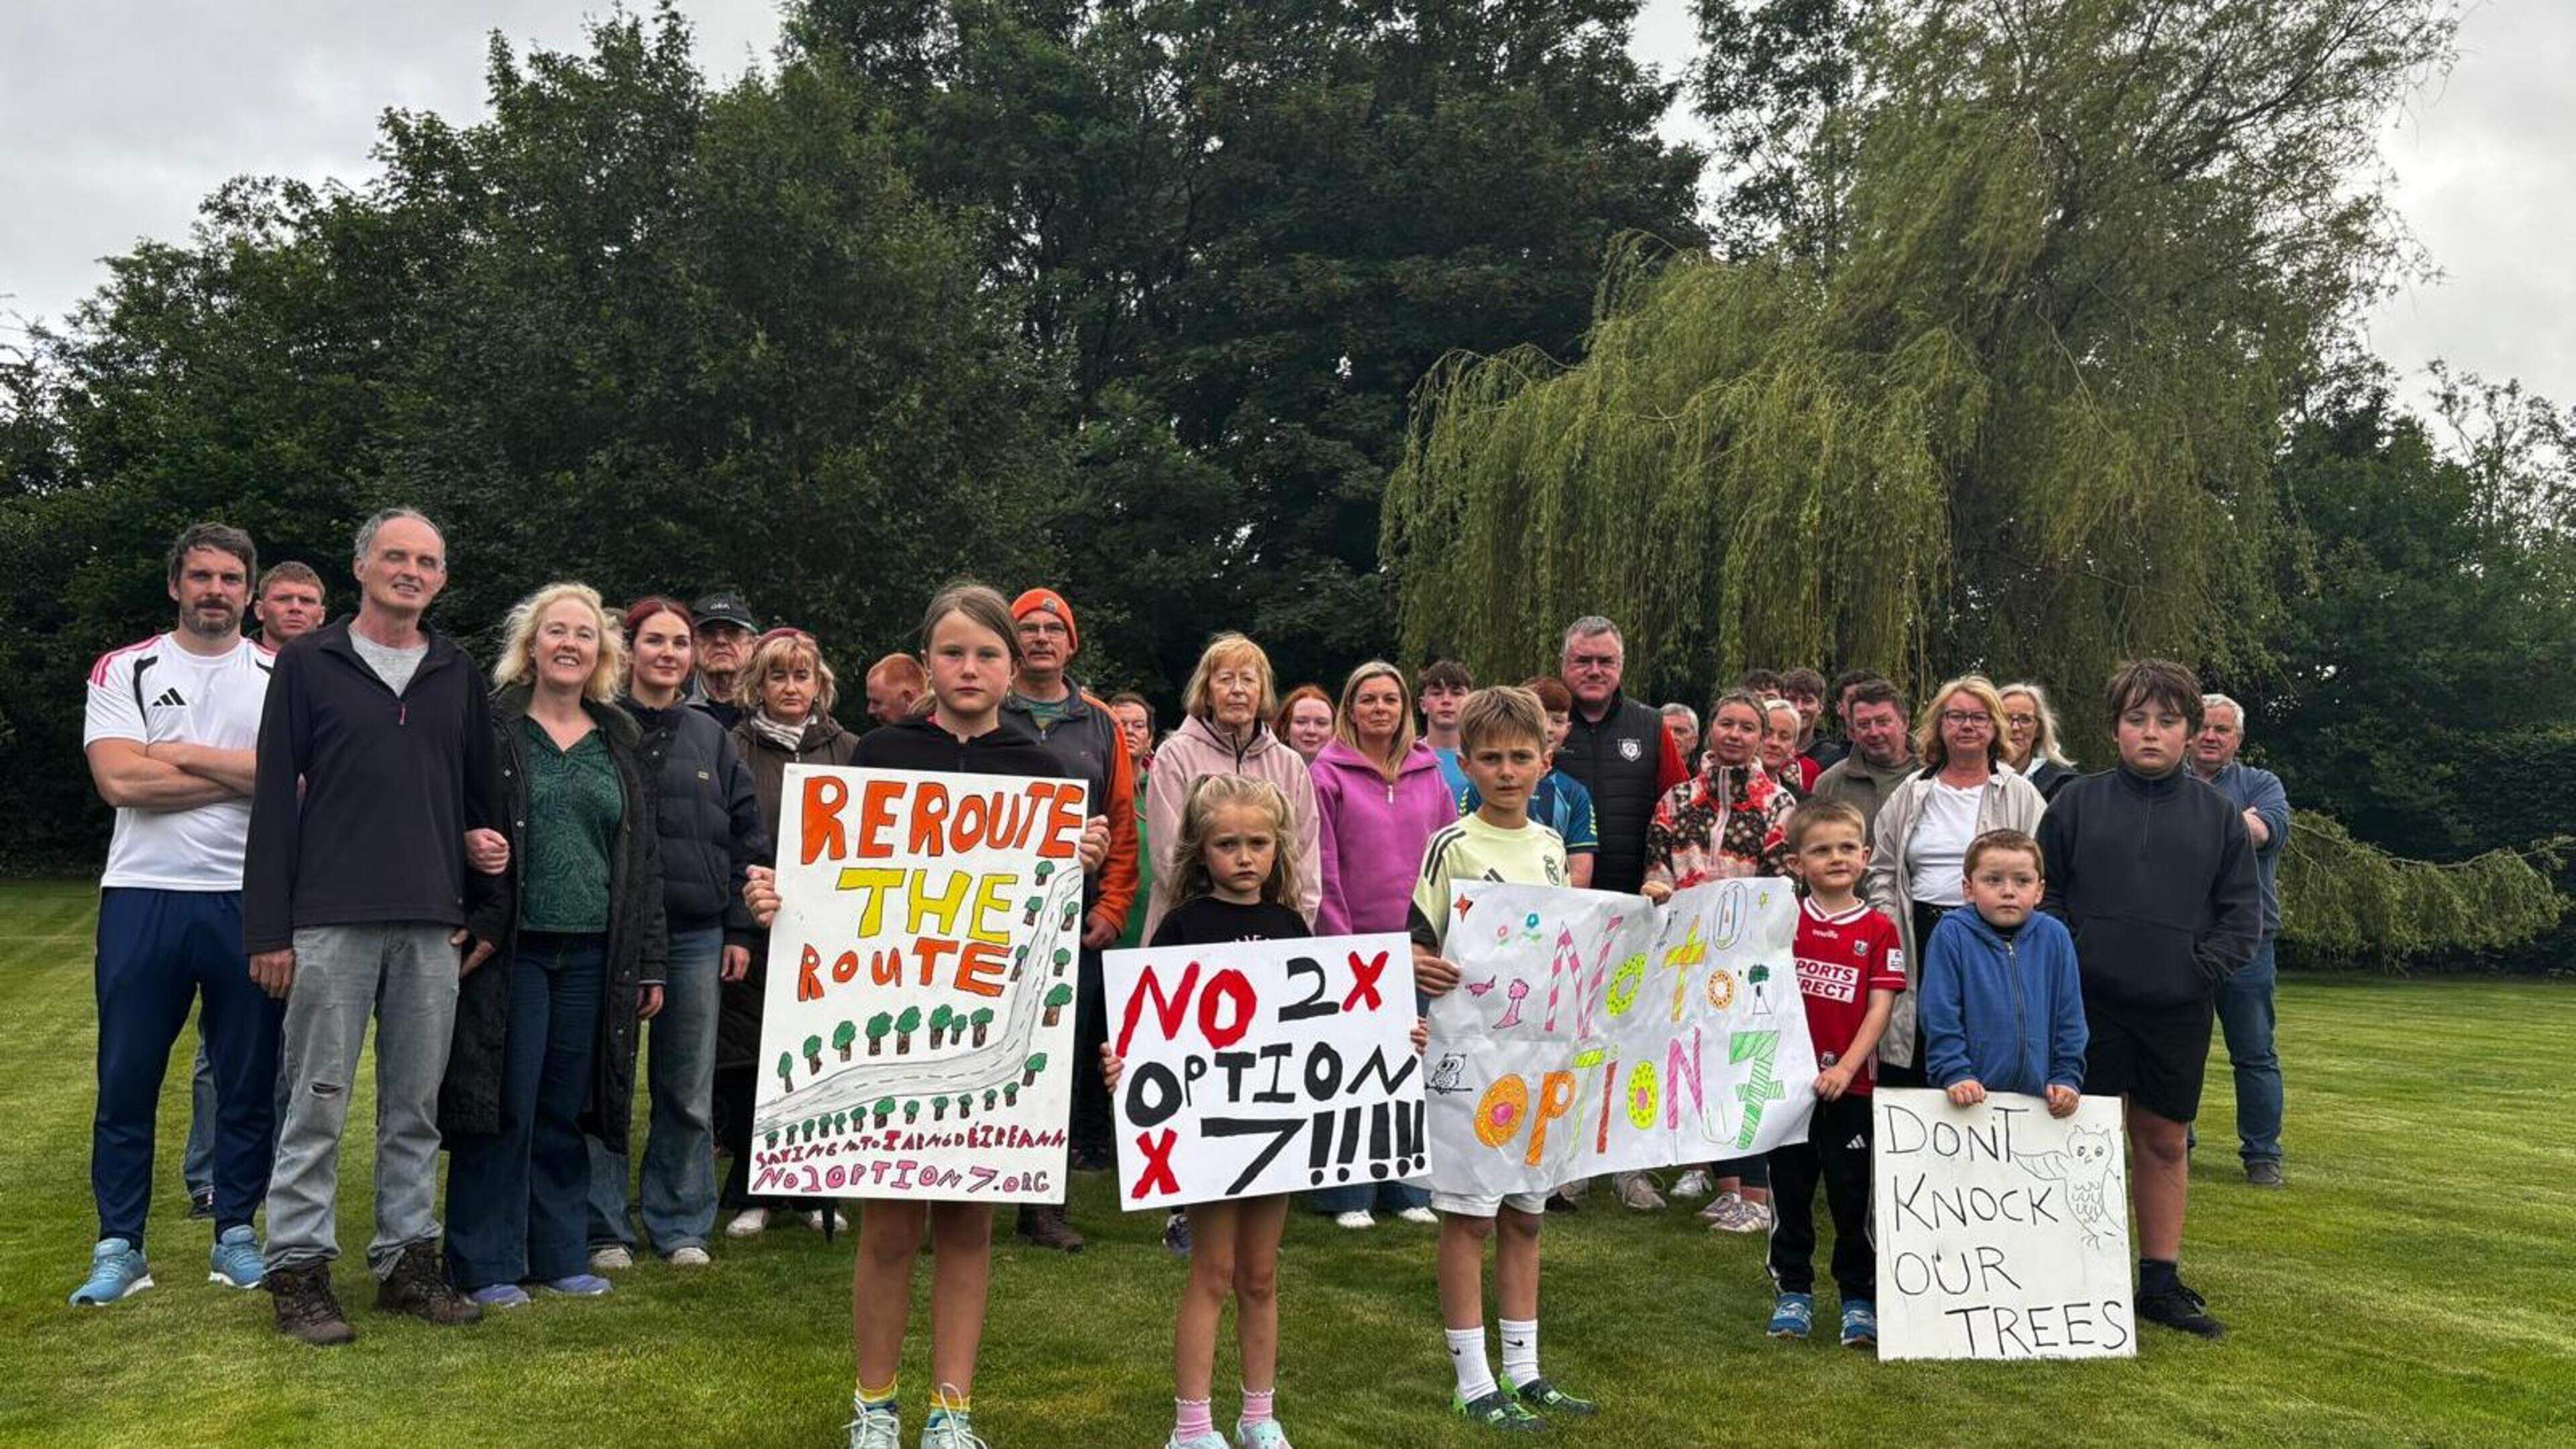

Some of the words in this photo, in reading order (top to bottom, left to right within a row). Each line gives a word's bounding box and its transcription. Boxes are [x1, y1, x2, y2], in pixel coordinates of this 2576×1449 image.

[801, 775, 1085, 865] REROUTE
[836, 867, 1018, 945] THE
[798, 937, 1013, 1002] ROUTE
[1796, 959, 1854, 982] PORTS
[1798, 977, 1850, 999] RECT
[1116, 961, 1257, 1059] NO
[1125, 1041, 1417, 1128] OPTION
[756, 1142, 838, 1170] SAYING
[1894, 1173, 2058, 1232] KNOCK
[1894, 1246, 2022, 1295] OUR
[1945, 1300, 2128, 1356] TREES
